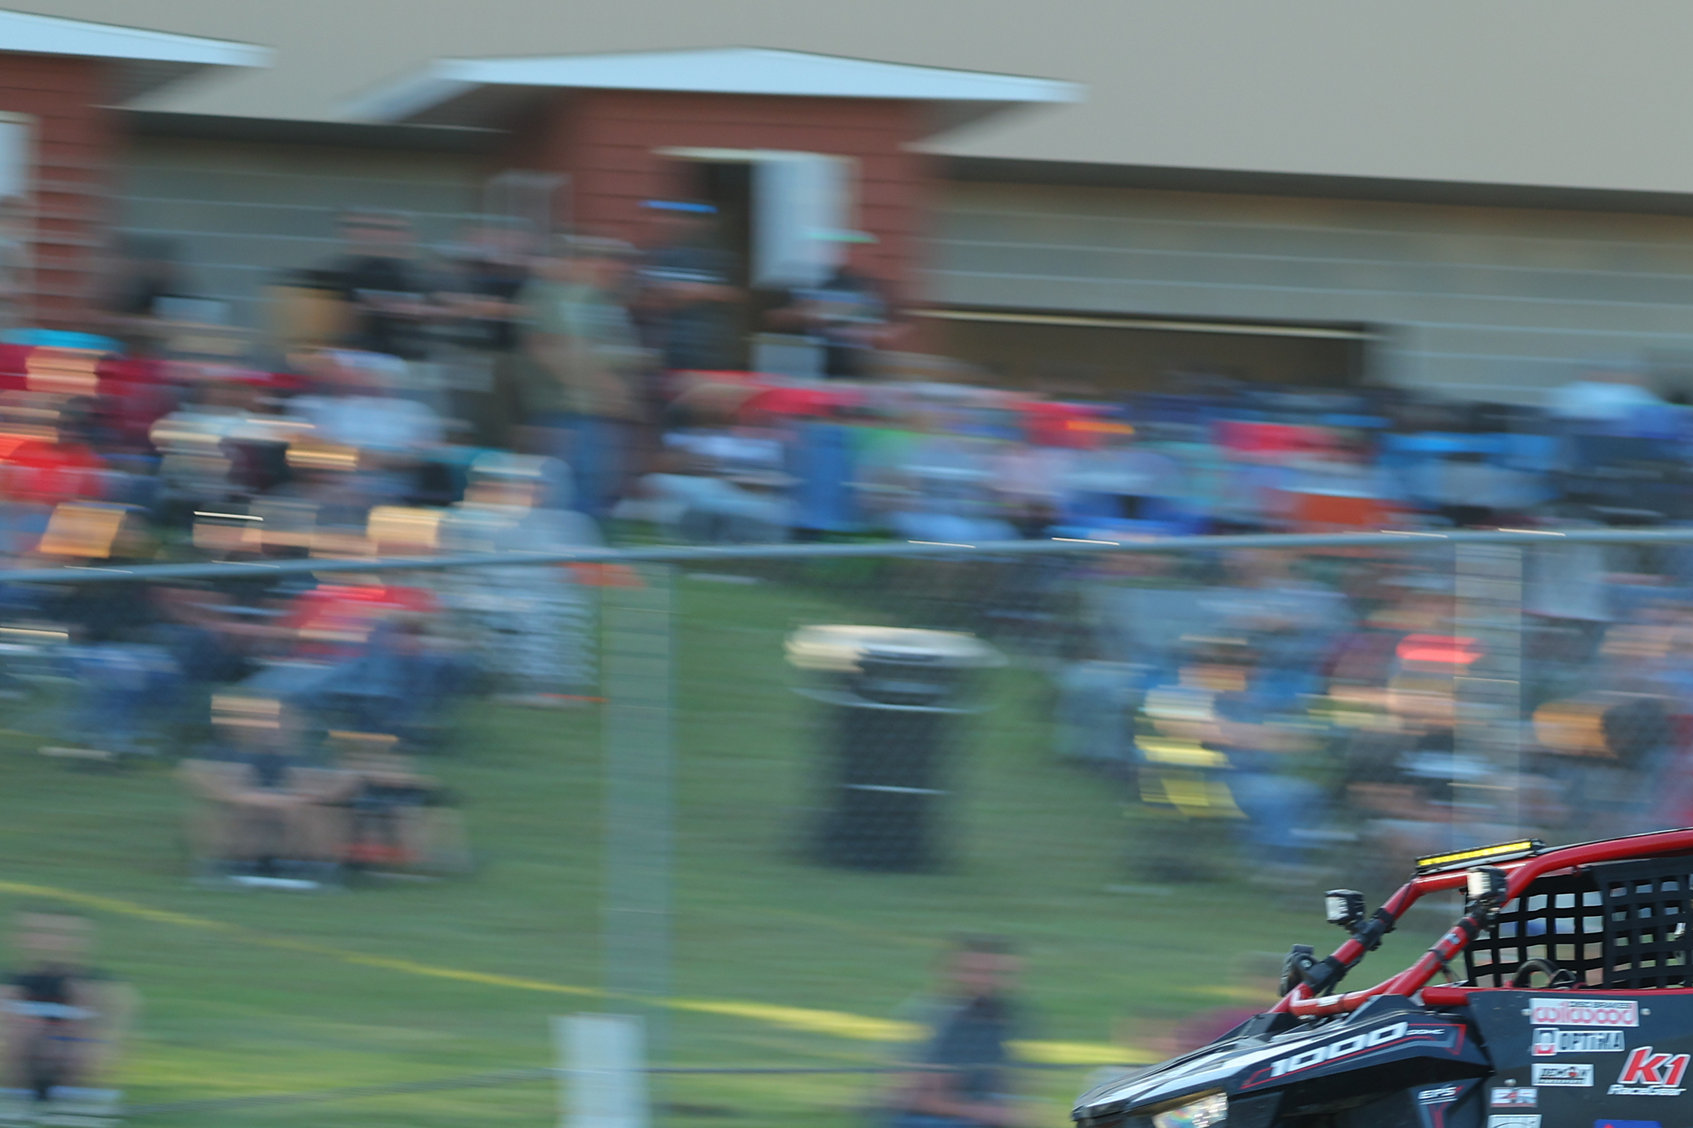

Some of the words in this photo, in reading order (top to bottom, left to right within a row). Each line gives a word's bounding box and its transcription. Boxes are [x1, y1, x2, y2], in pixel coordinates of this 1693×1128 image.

[1534, 1001, 1637, 1025] wilwood
[1269, 1022, 1408, 1077] 1000
[1617, 1046, 1691, 1088] K1
